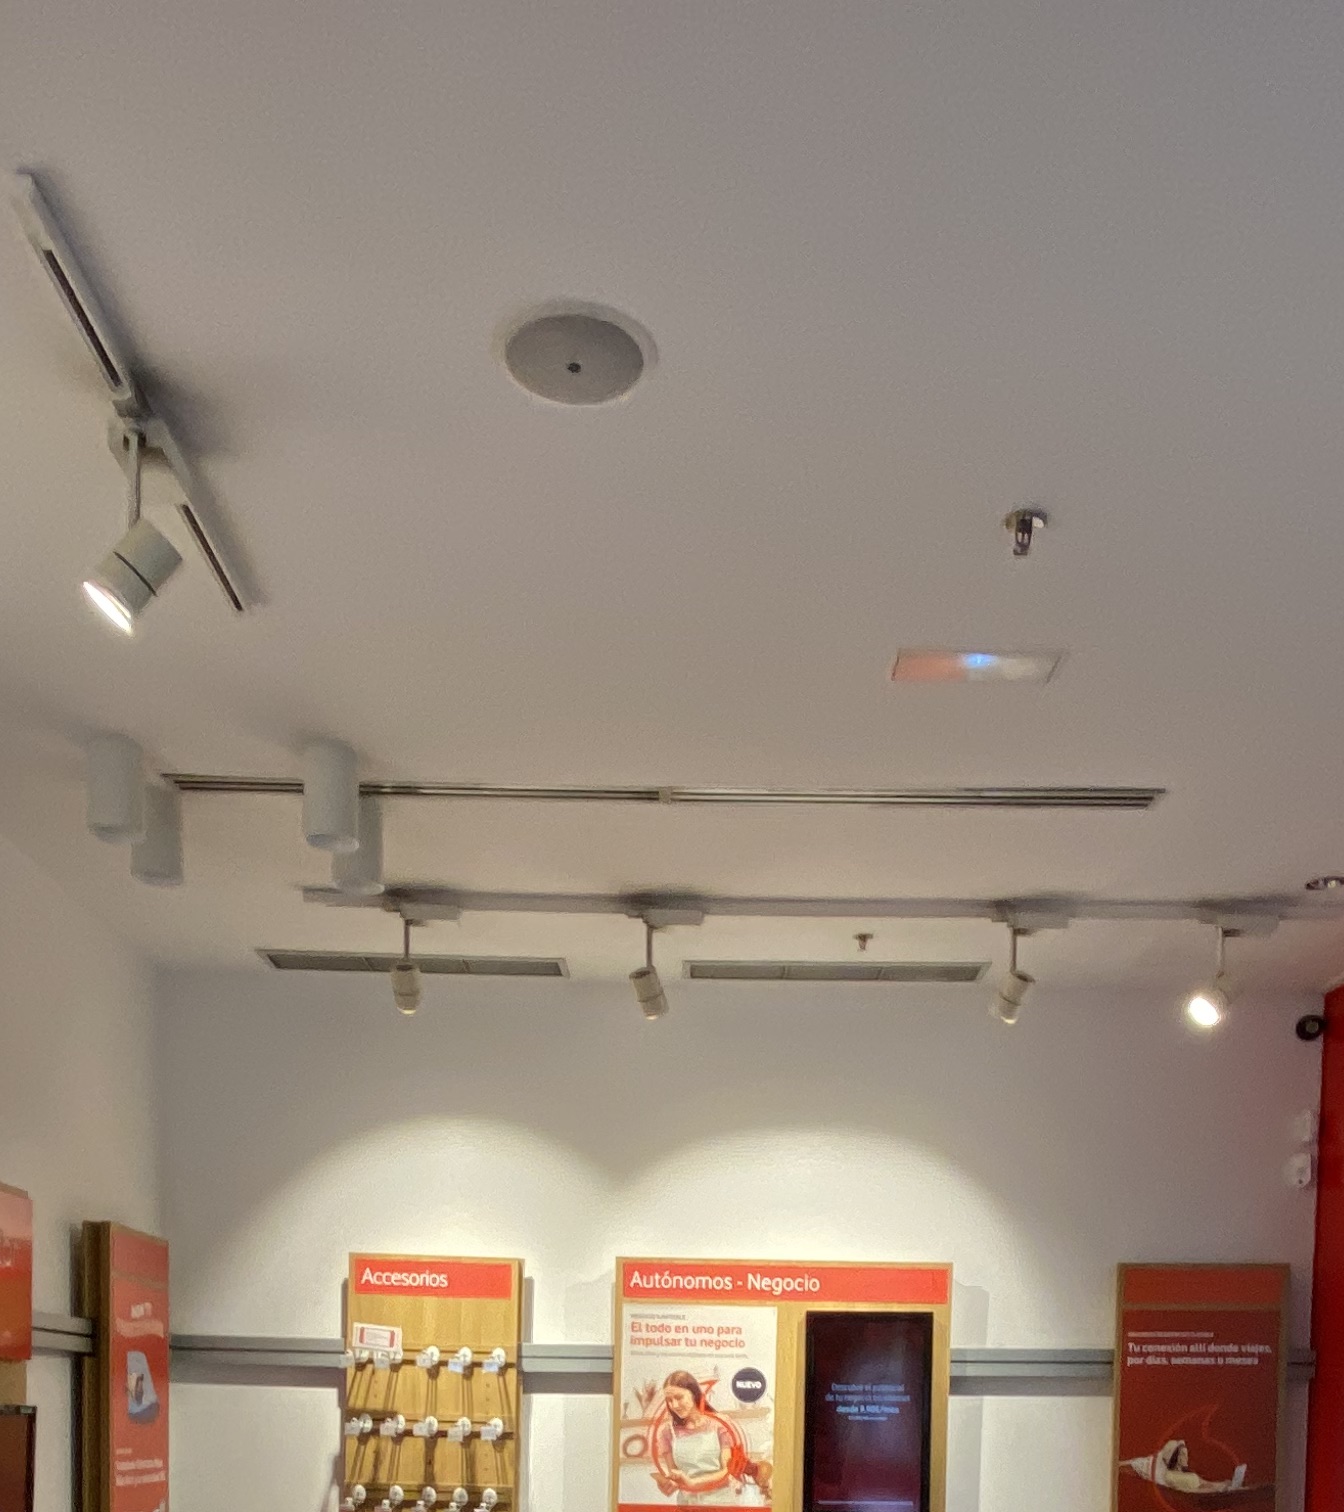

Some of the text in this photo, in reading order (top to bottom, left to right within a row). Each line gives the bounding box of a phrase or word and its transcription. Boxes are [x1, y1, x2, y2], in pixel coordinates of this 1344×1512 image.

[360, 1267, 449, 1288] Accesorios
[629, 1270, 734, 1291] Autónomos
[747, 1273, 821, 1295] Negocio
[630, 1321, 743, 1337] El todo en uno para
[630, 1335, 746, 1351] impulsar tu negocio
